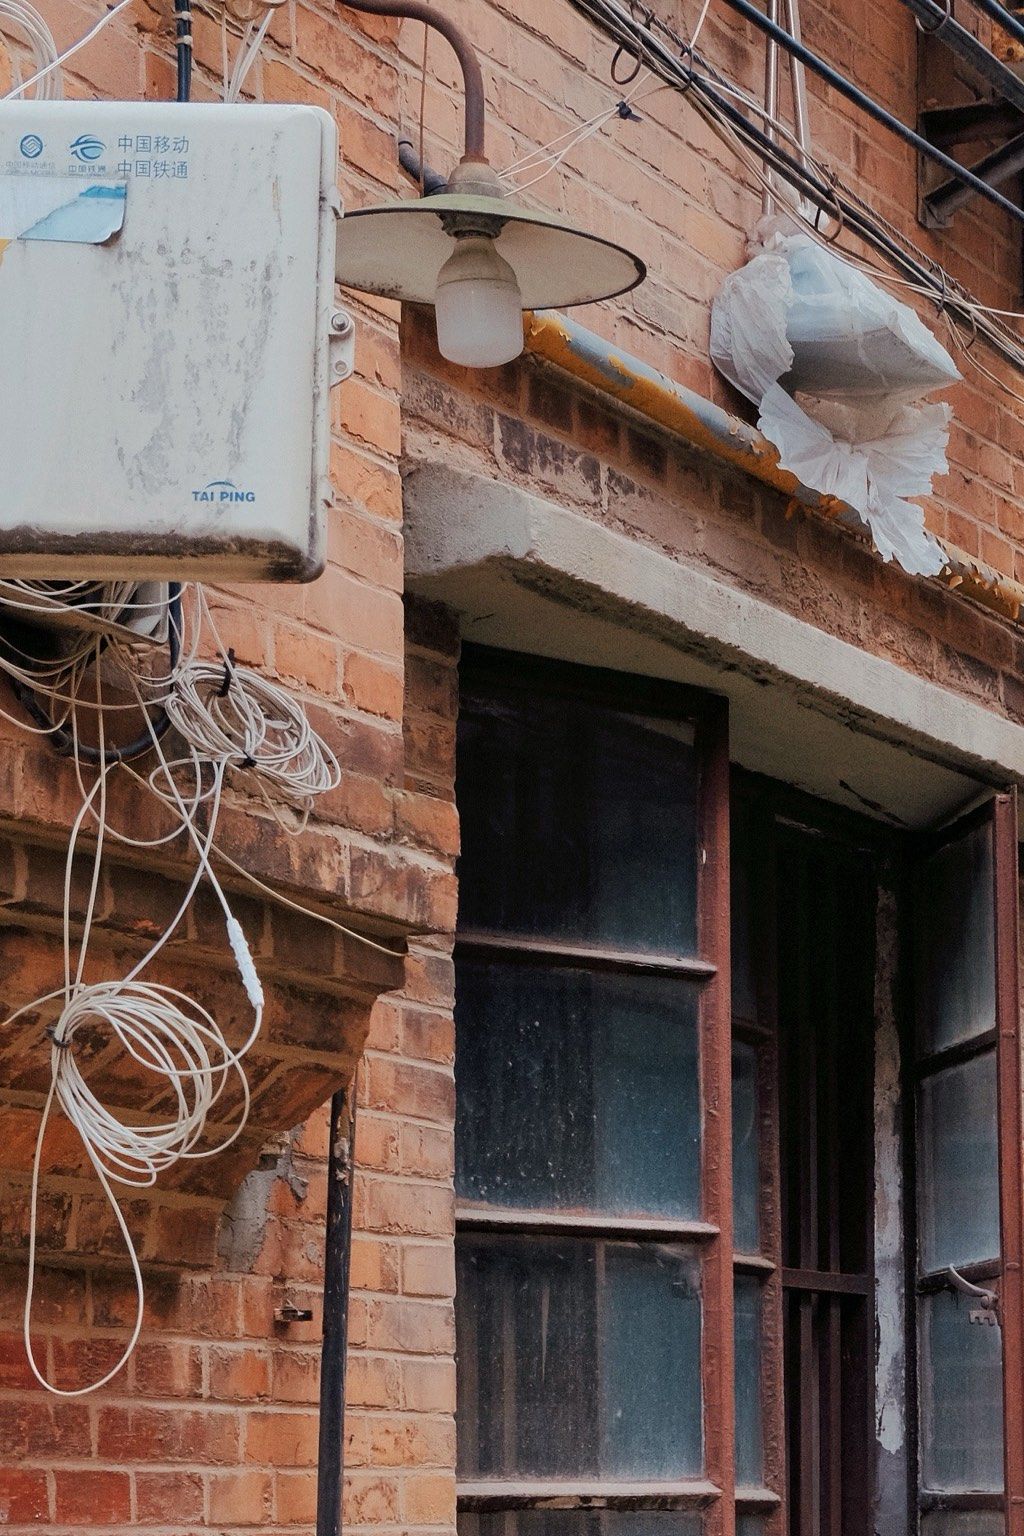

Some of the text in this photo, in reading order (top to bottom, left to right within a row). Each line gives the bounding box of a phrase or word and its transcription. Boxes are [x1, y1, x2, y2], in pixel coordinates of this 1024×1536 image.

[118, 135, 189, 154] 中国移动
[117, 159, 189, 179] 中国铁通
[192, 491, 256, 502] TAI PING
